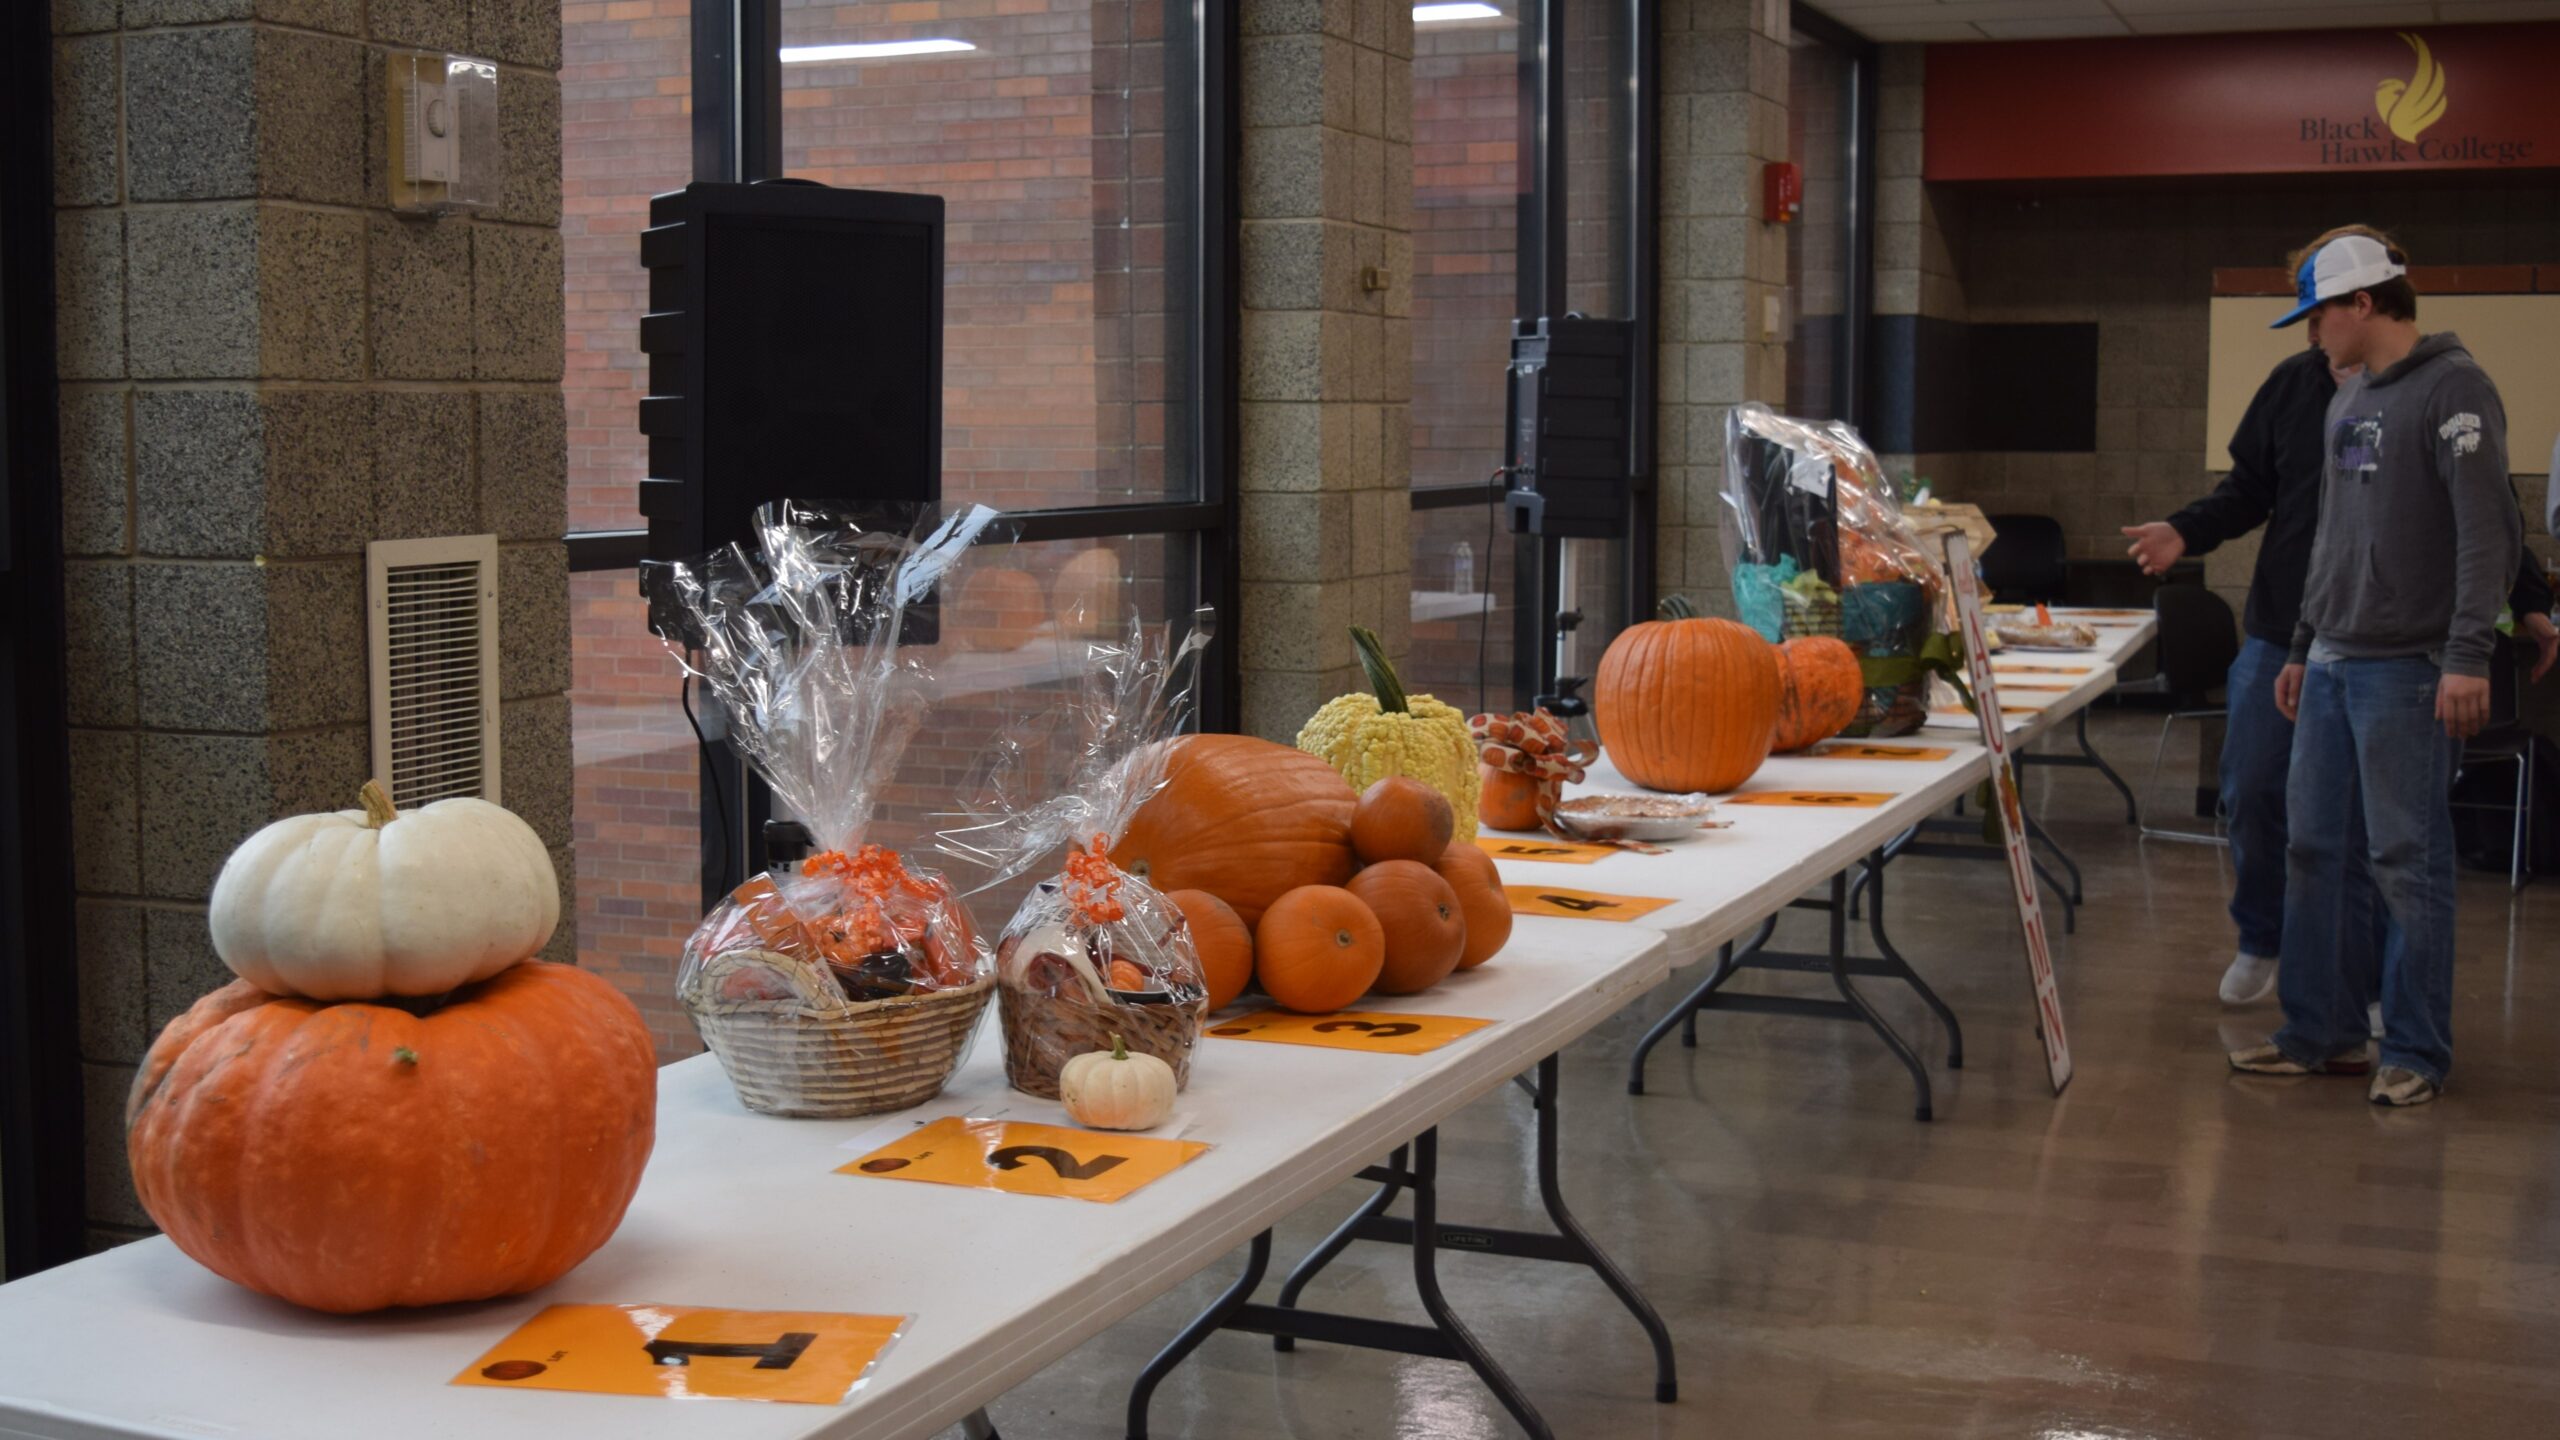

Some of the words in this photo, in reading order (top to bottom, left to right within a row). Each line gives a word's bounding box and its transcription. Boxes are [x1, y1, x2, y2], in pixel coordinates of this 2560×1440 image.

[2300, 117, 2379, 141] Black
[2320, 140, 2407, 164] Hawk
[2418, 137, 2534, 163] College
[1498, 845, 1577, 855] 5
[1537, 894, 1622, 912] 4
[1312, 1020, 1421, 1037] 3
[987, 1145, 1130, 1180] 2
[642, 1332, 818, 1370] 1
